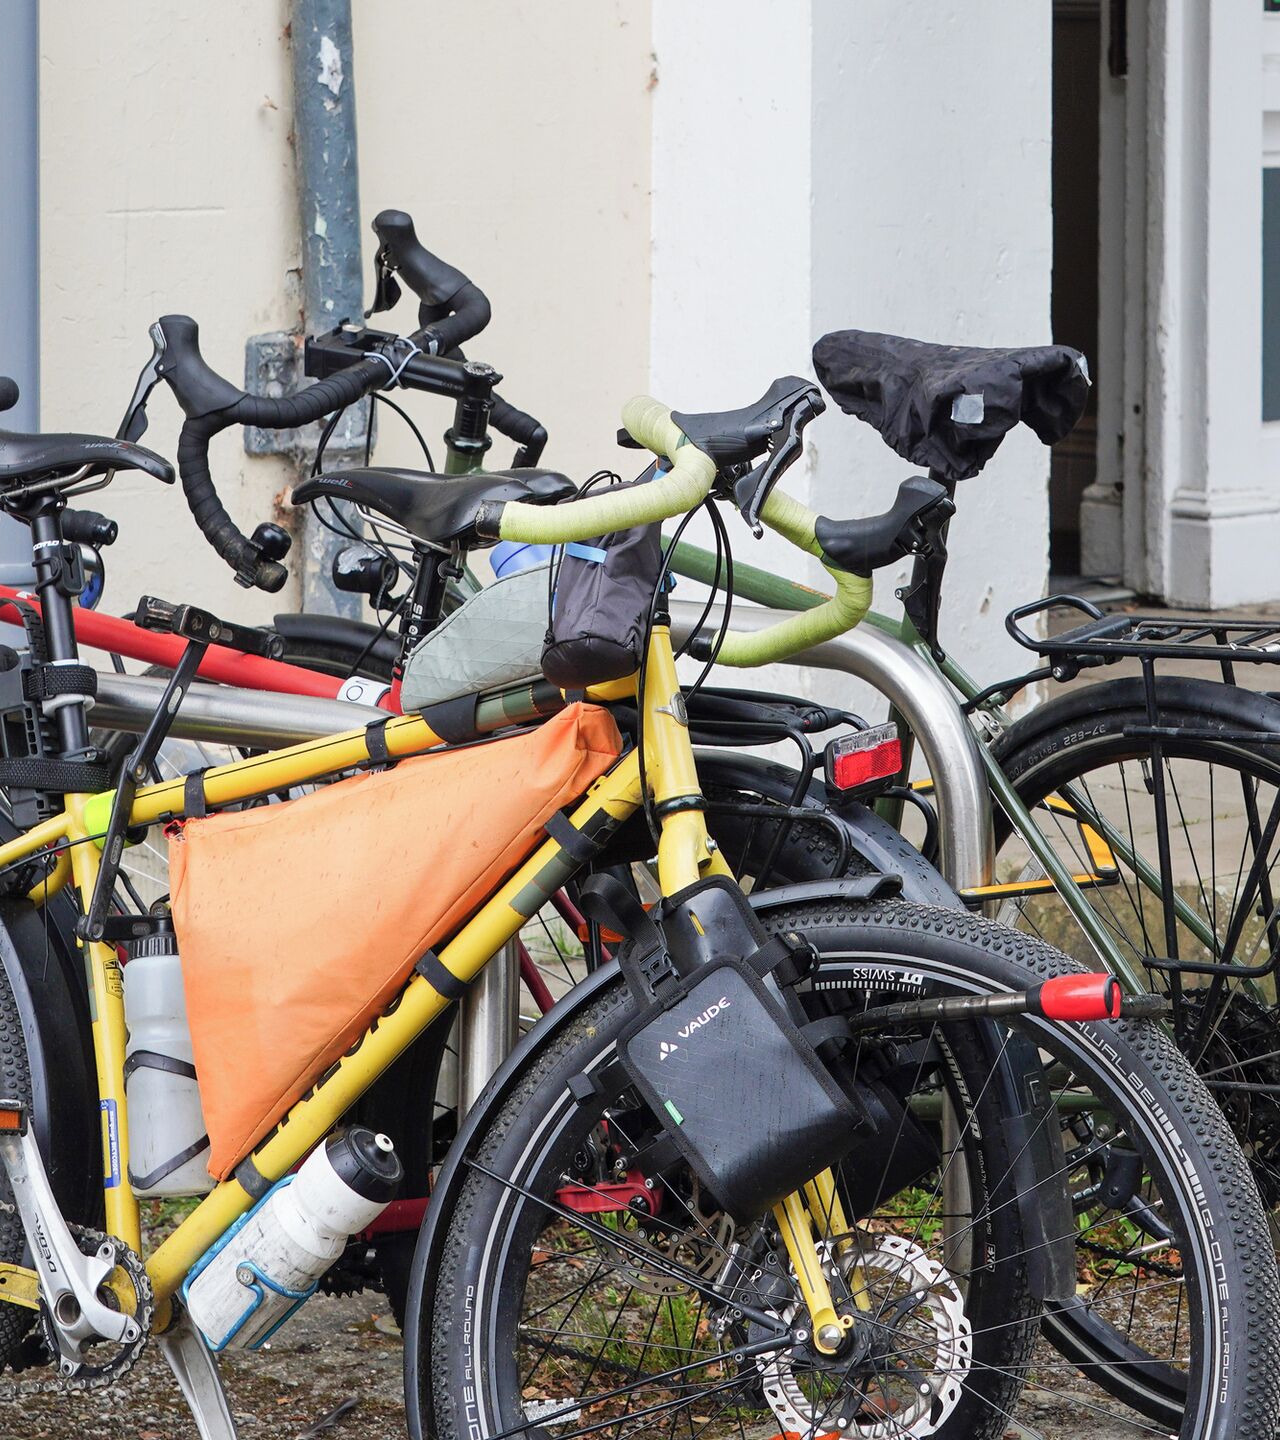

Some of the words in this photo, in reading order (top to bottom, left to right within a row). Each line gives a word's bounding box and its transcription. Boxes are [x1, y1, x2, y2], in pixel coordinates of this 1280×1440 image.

[853, 967, 896, 981] SWISS
[899, 971, 925, 986] DT
[677, 996, 731, 1038] VAUDE
[1202, 1208, 1230, 1301] G-ONE
[1219, 1306, 1231, 1404] ALLROUND
[463, 1285, 475, 1380] ALLROUND
